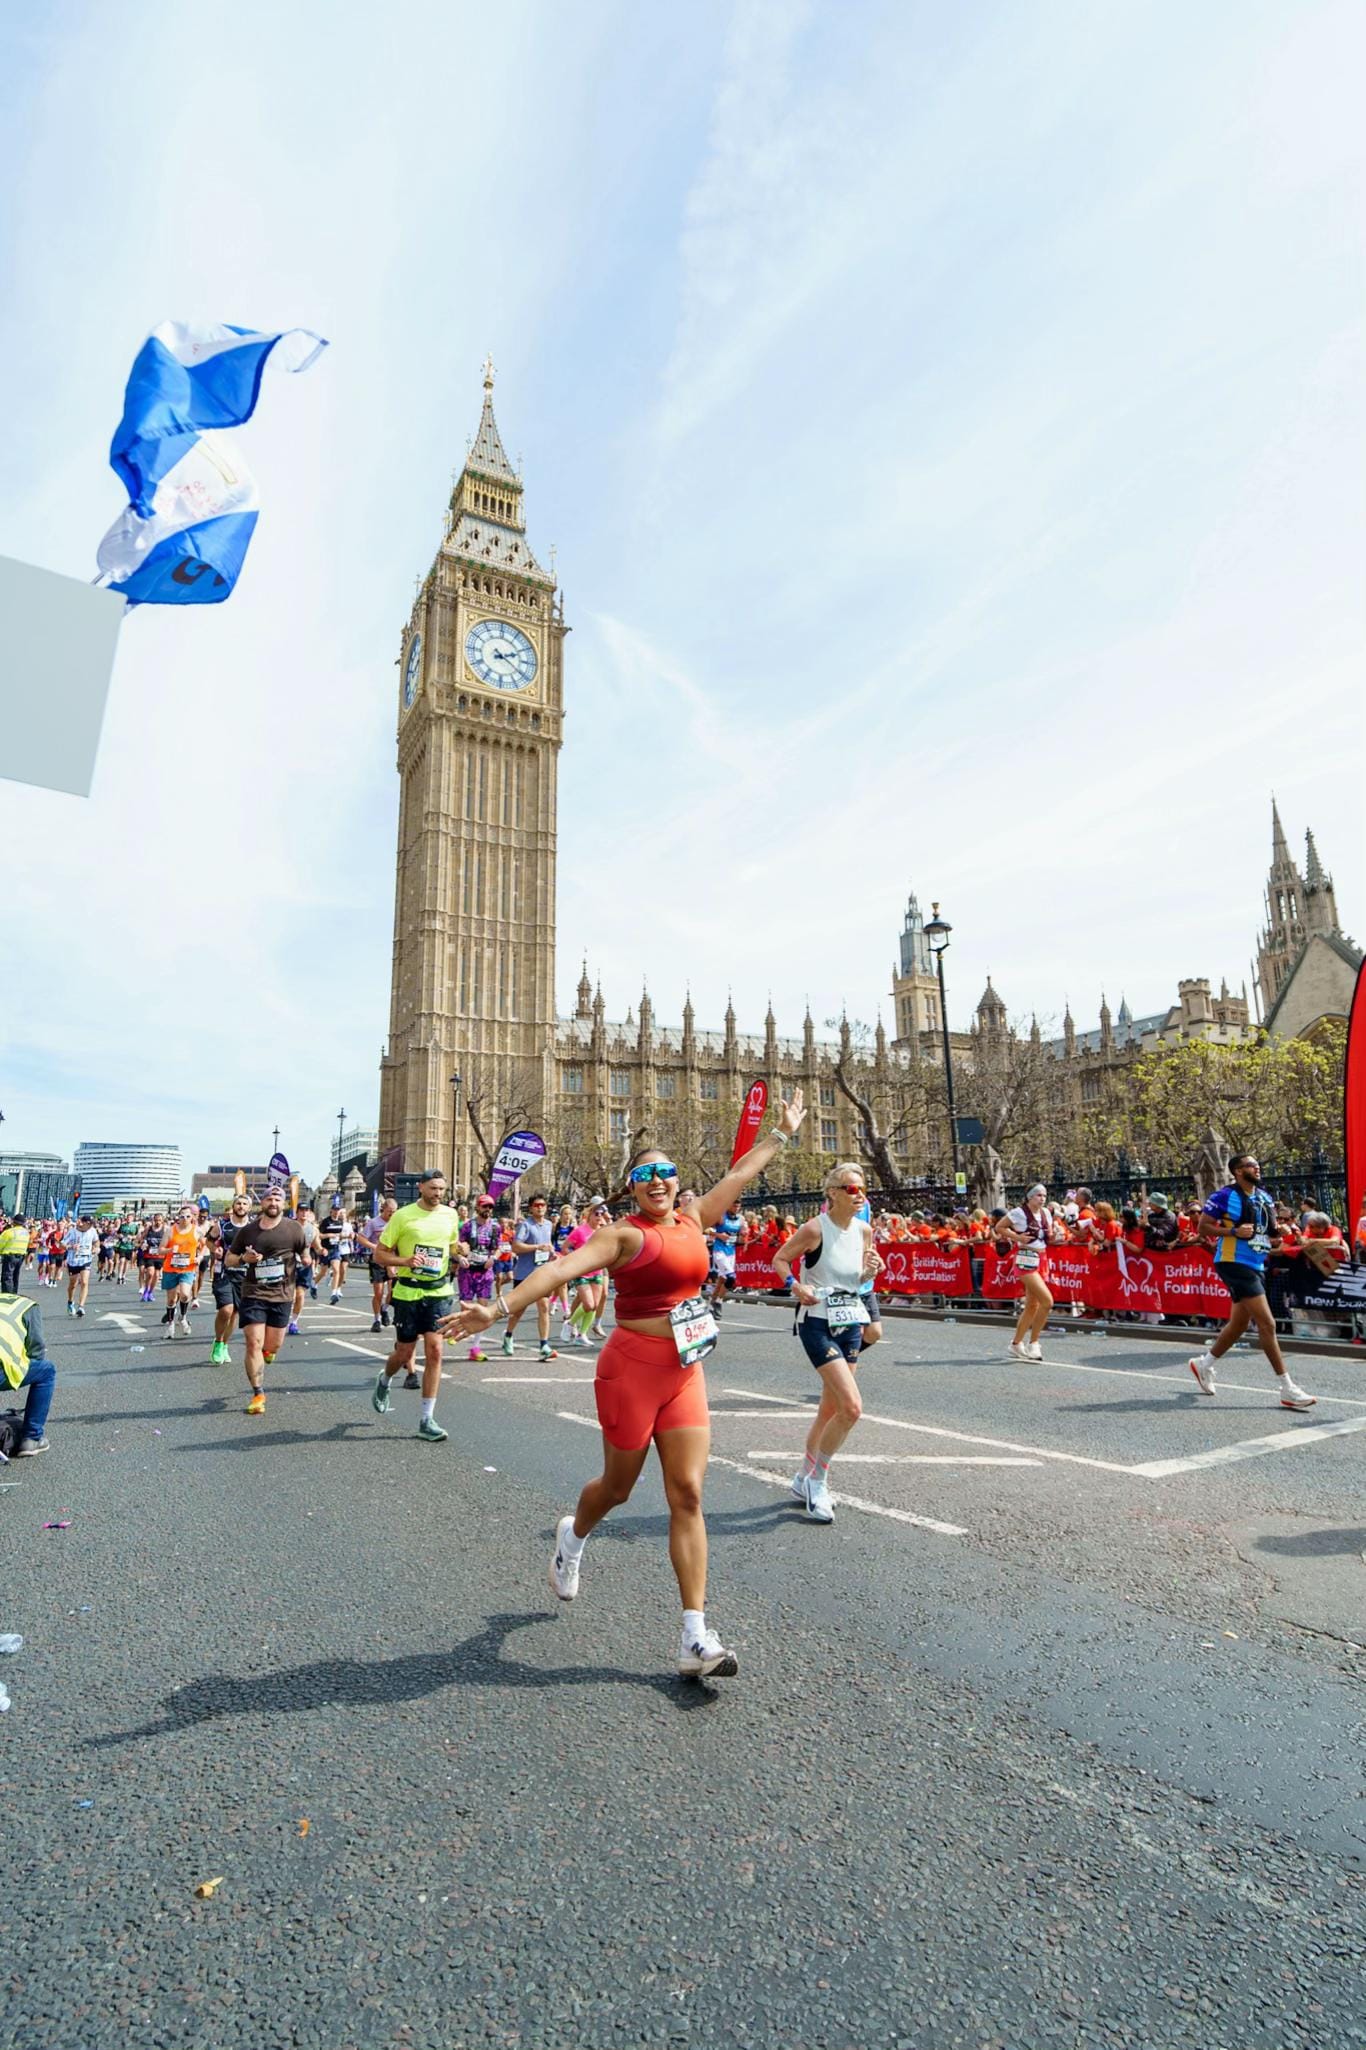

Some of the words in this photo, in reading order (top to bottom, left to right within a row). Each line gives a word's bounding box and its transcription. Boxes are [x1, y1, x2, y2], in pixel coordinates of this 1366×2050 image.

[499, 1155, 529, 1170] 4:05
[1059, 1260, 1090, 1274] Heart
[1305, 1296, 1334, 1307] new
